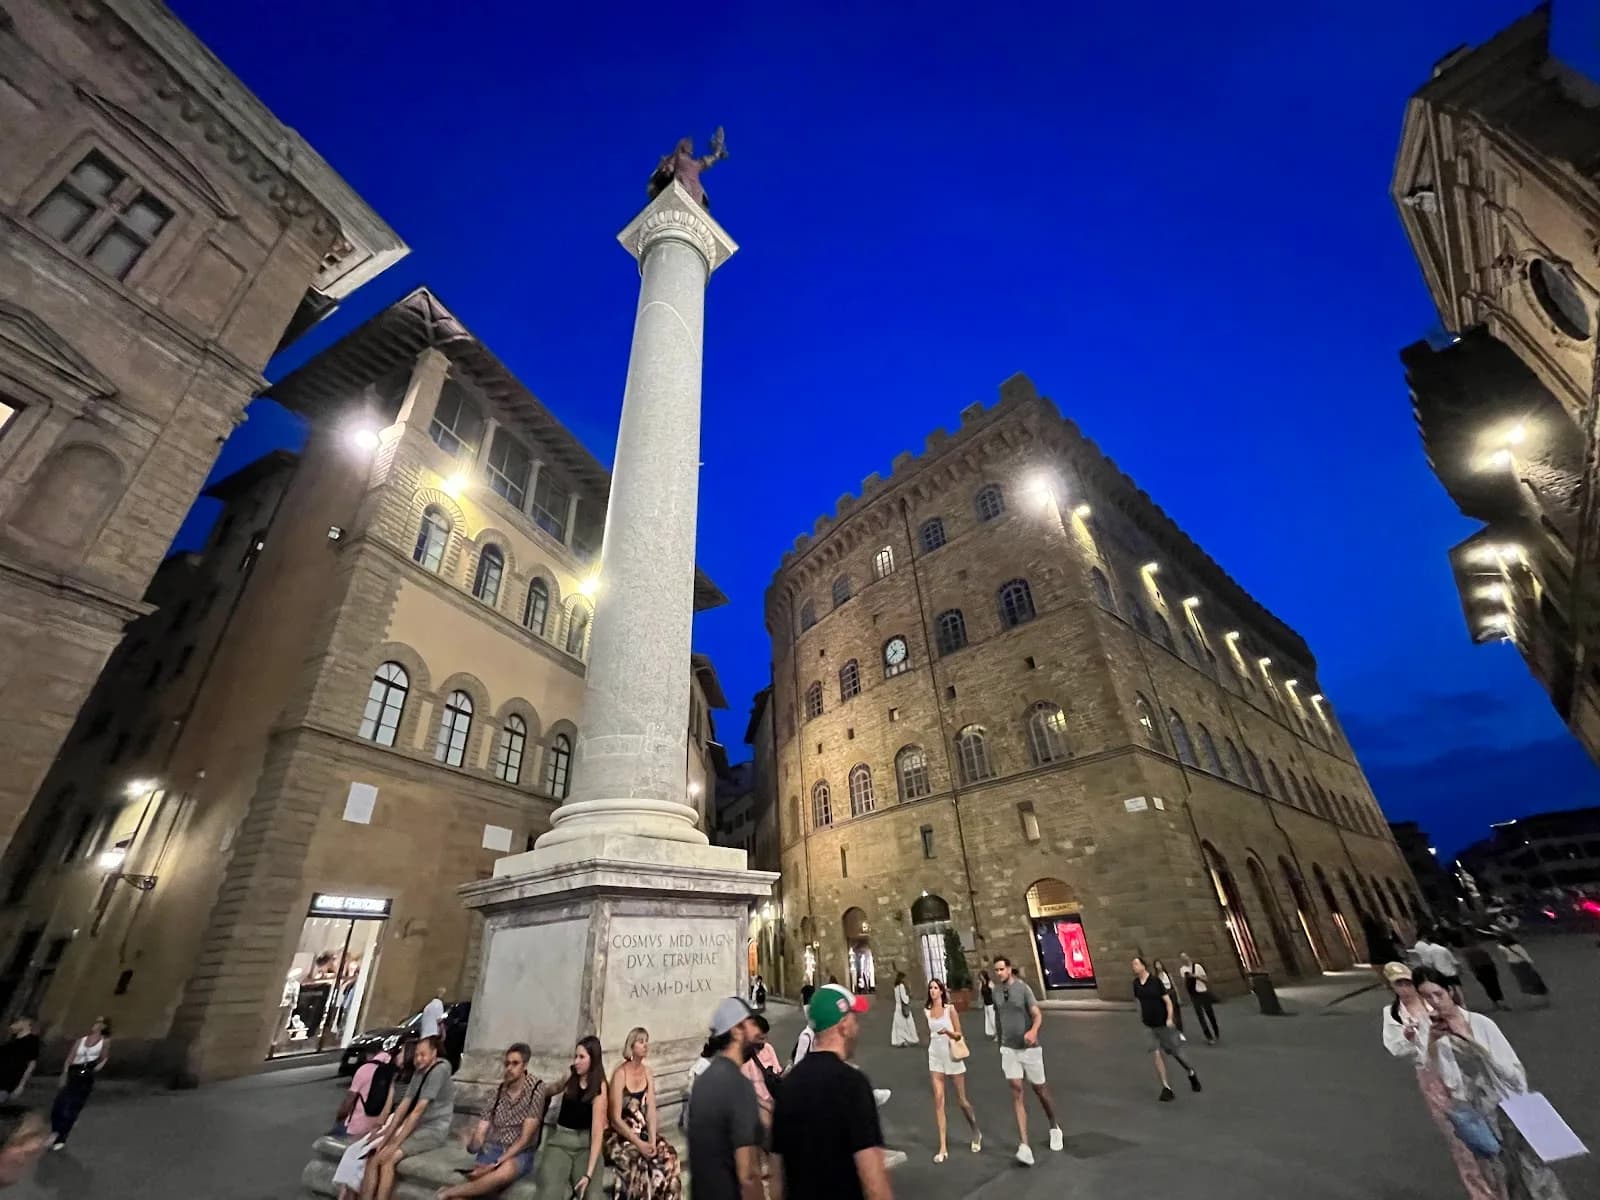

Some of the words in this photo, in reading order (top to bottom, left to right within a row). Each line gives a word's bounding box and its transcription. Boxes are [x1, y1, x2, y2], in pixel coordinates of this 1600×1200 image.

[612, 934, 663, 949] COSMVS
[669, 934, 694, 948] MED
[626, 953, 655, 969] DVX
[663, 952, 719, 967] ETRVRIAE
